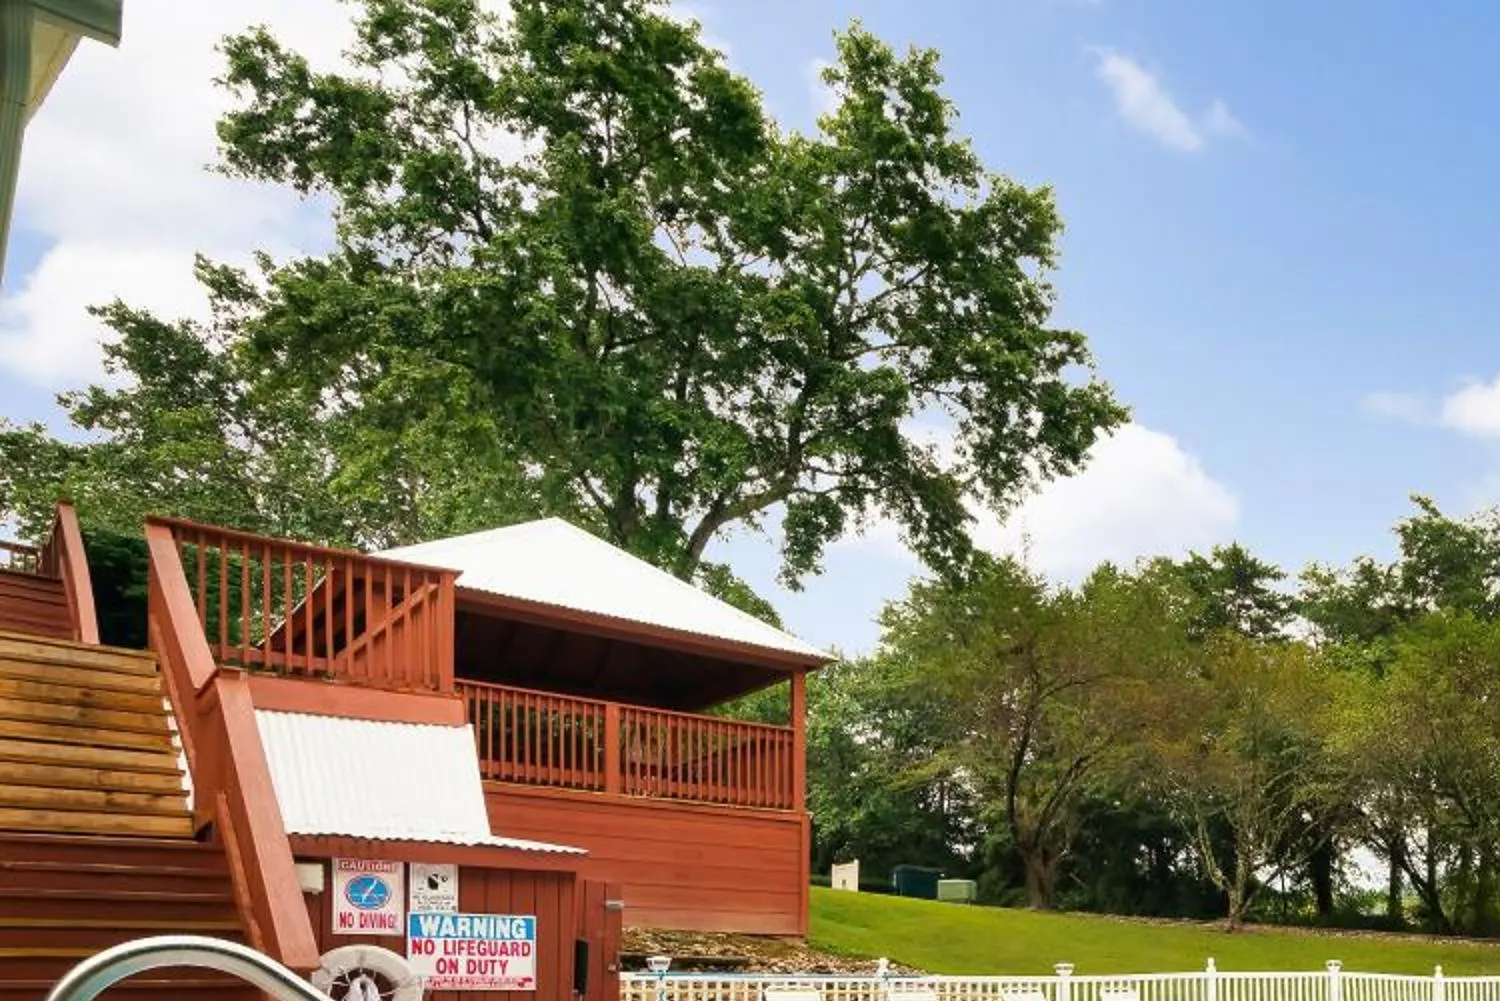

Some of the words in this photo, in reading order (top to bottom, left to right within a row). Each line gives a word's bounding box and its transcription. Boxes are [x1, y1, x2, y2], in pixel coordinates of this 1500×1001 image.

[339, 911, 355, 928] NO
[418, 915, 528, 939] WARNING
[411, 939, 435, 955] NO
[443, 940, 532, 957] LIFEGUARD
[436, 958, 459, 974] ON
[466, 959, 509, 974] DUTY
